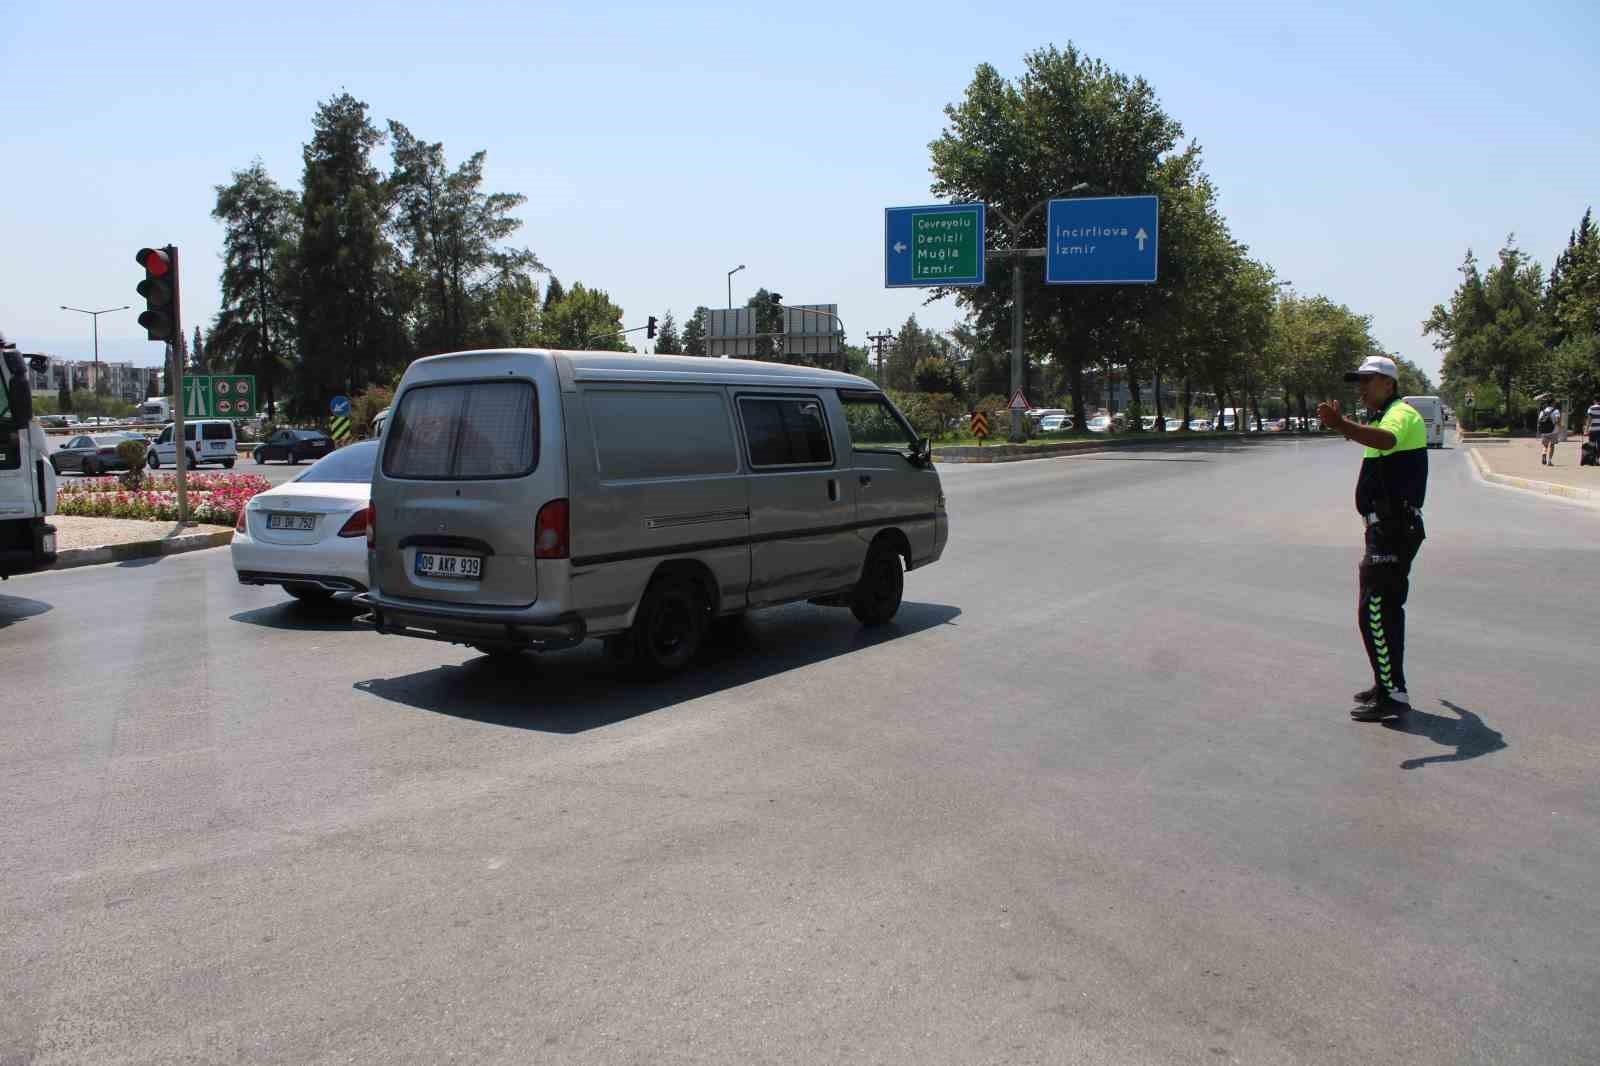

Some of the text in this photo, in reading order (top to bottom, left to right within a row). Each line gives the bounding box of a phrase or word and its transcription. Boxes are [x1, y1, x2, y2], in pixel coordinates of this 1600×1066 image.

[918, 233, 963, 244] Denizli
[439, 556, 456, 572] AKR
[461, 558, 479, 574] 939
